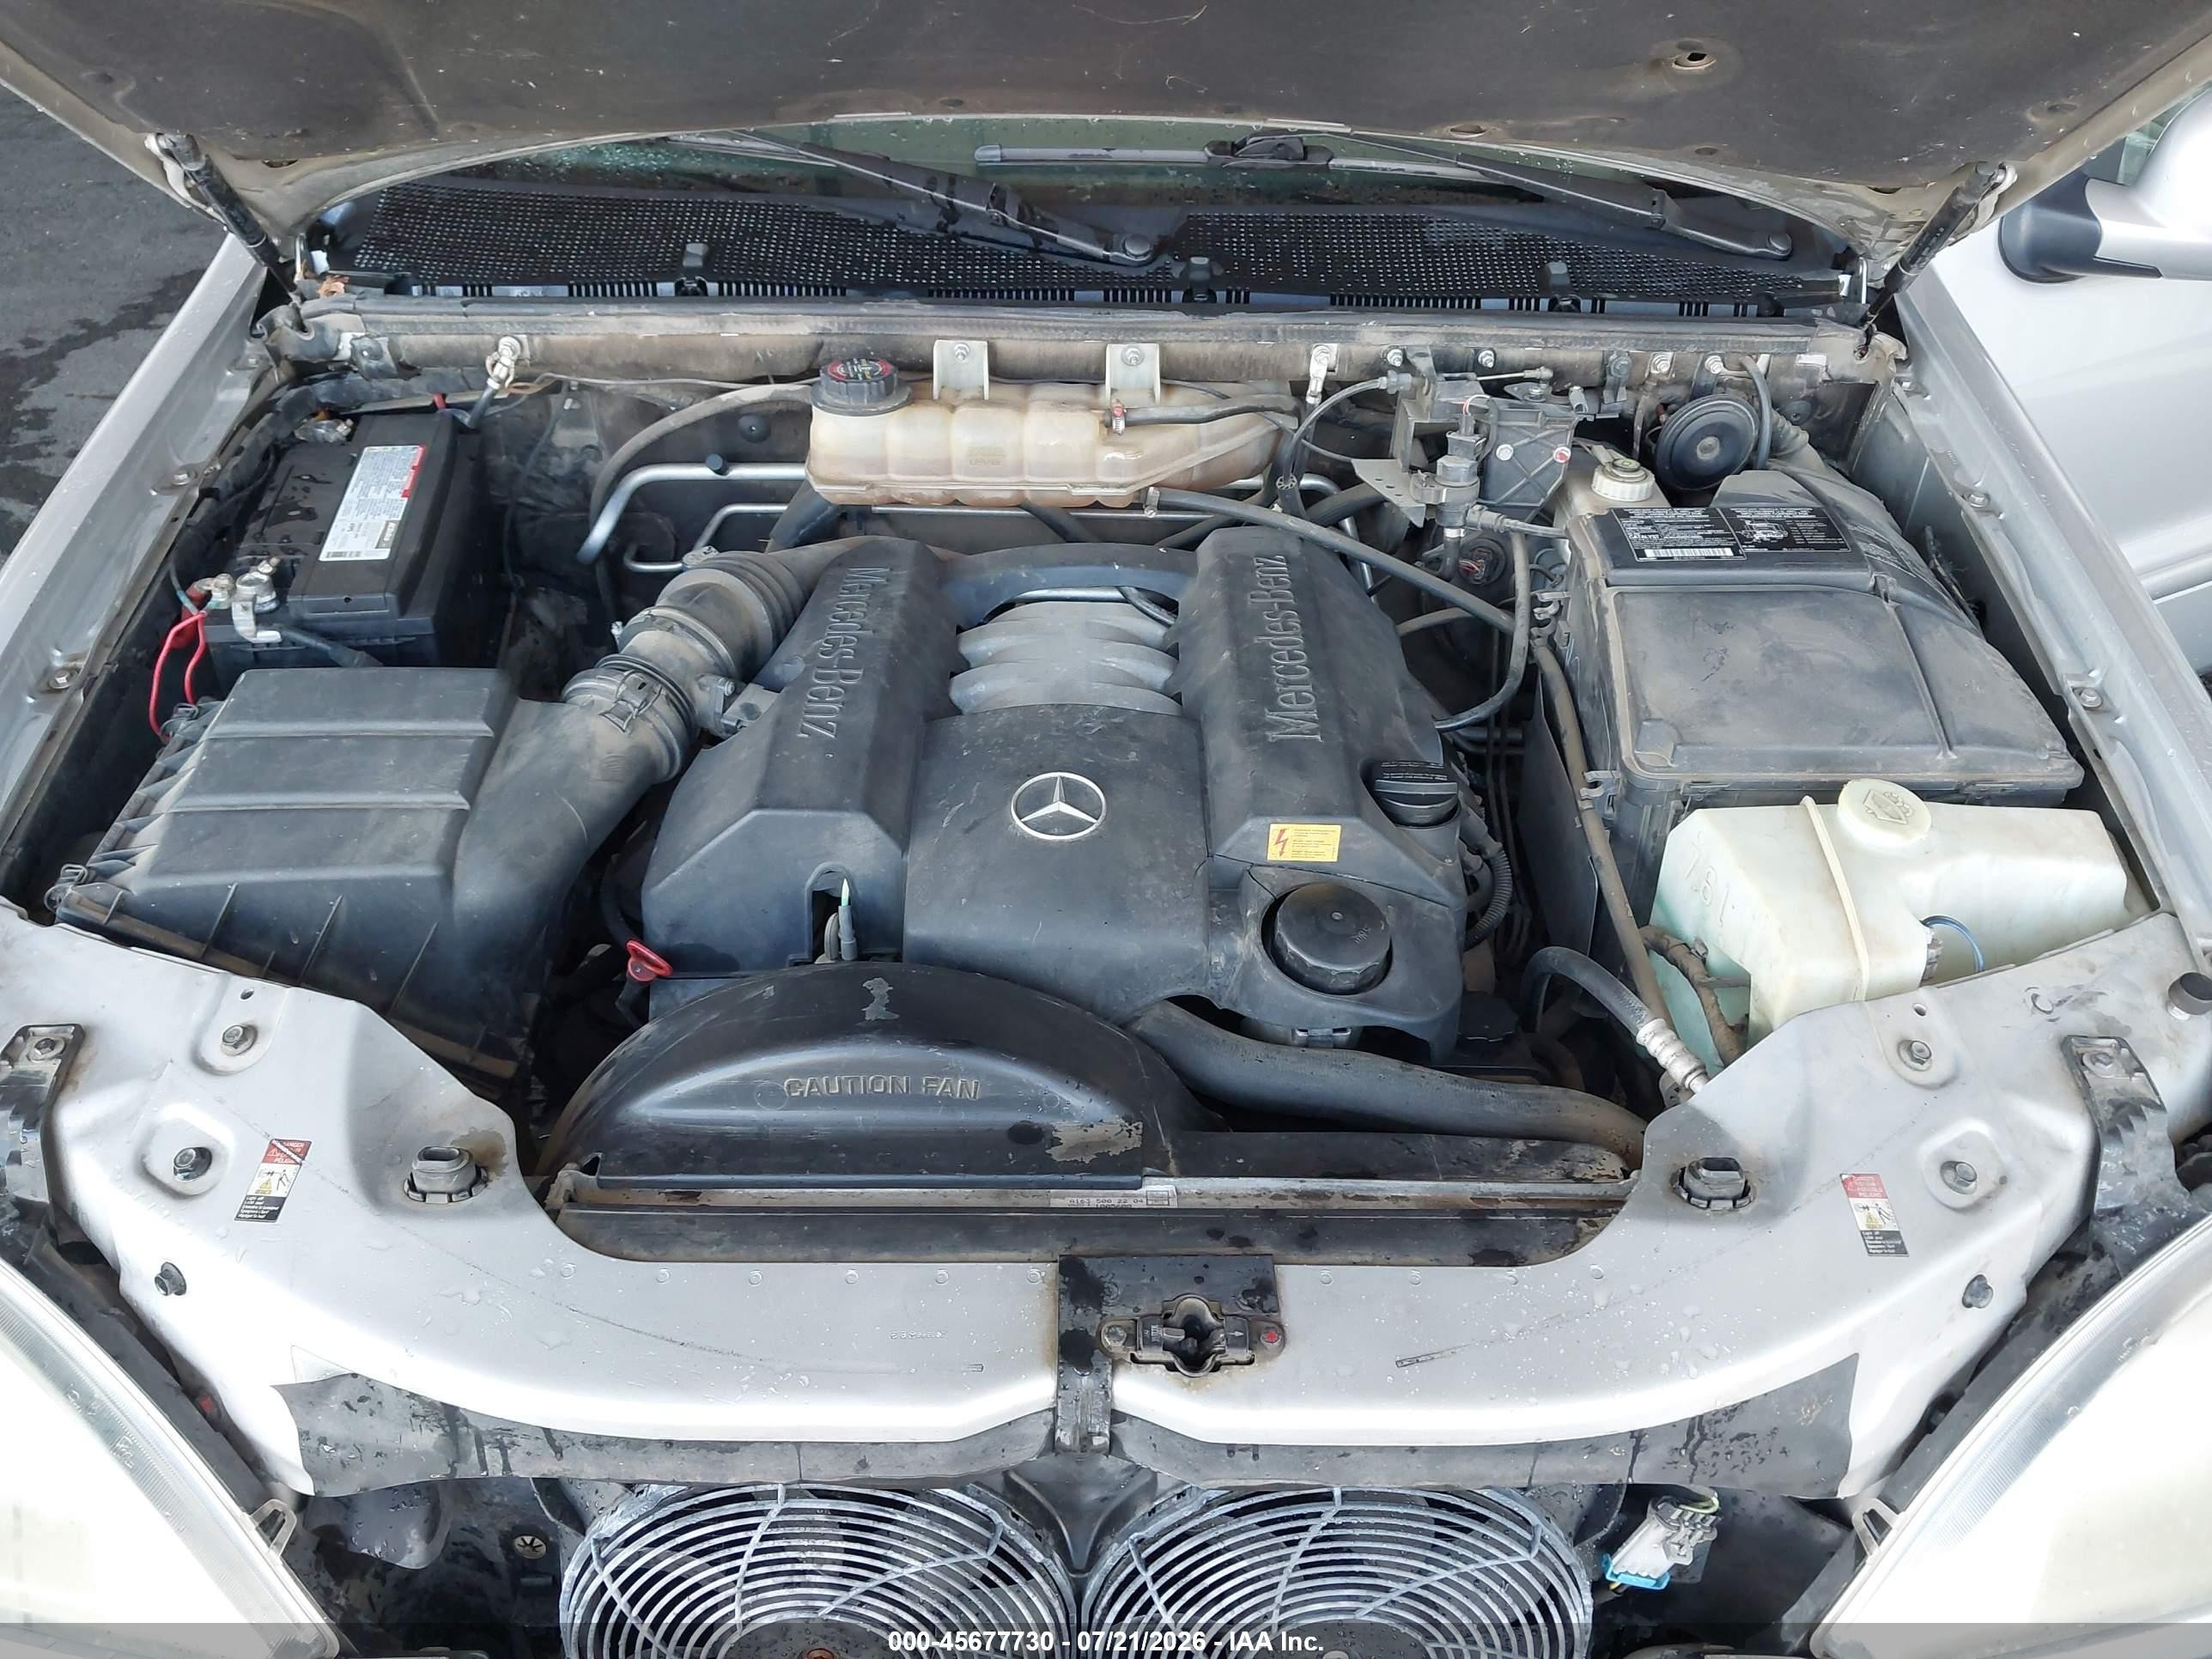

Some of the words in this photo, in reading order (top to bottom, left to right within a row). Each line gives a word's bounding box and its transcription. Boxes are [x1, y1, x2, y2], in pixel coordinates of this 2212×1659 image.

[797, 567, 891, 738] Mercedes-Benz
[1248, 555, 1323, 743] Mercedes-Benz
[783, 1074, 911, 1097] CAUTION
[922, 1076, 981, 1100] FAN
